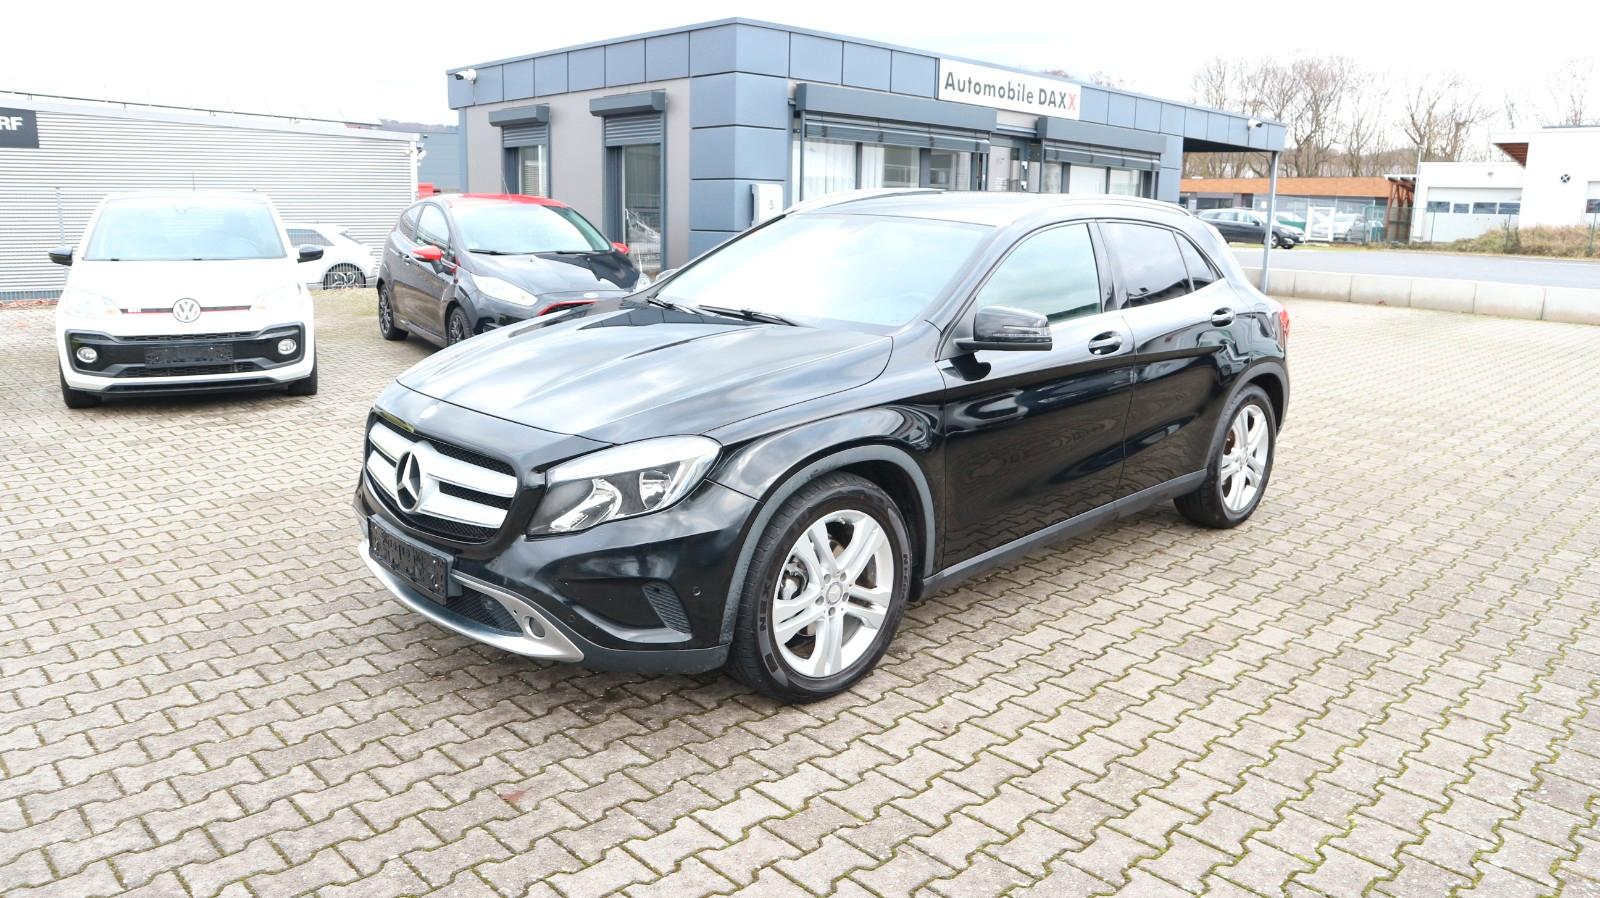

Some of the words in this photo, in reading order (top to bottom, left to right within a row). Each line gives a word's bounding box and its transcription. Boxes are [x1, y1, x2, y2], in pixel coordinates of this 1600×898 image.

[944, 71, 1034, 104] Automobile
[1038, 87, 1077, 111] DAXX
[0, 115, 23, 131] RF
[174, 298, 200, 322] VW
